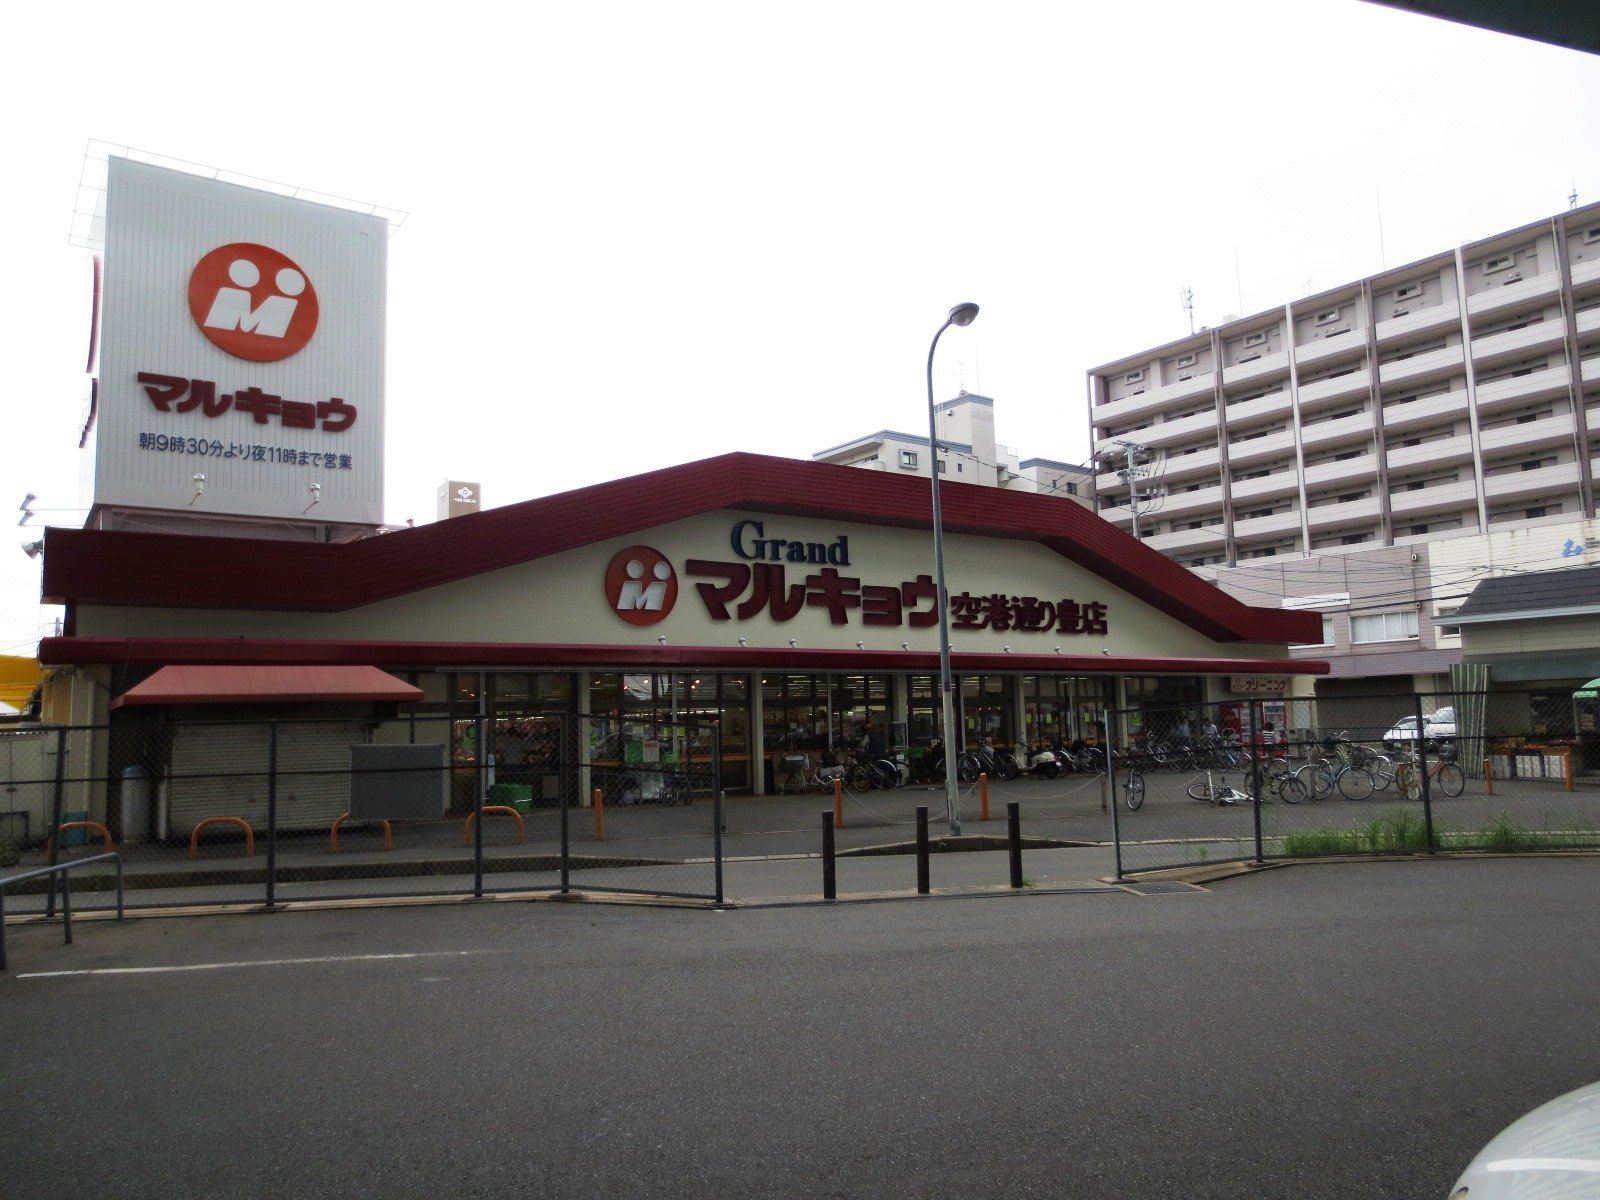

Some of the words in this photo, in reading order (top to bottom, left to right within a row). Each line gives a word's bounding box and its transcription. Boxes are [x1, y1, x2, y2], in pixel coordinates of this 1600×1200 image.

[137, 371, 357, 432] マルキョウ
[139, 431, 353, 470] 朝9時30分より夜11時まで営業
[730, 519, 852, 566] Grand
[685, 558, 948, 628] マルキョウ
